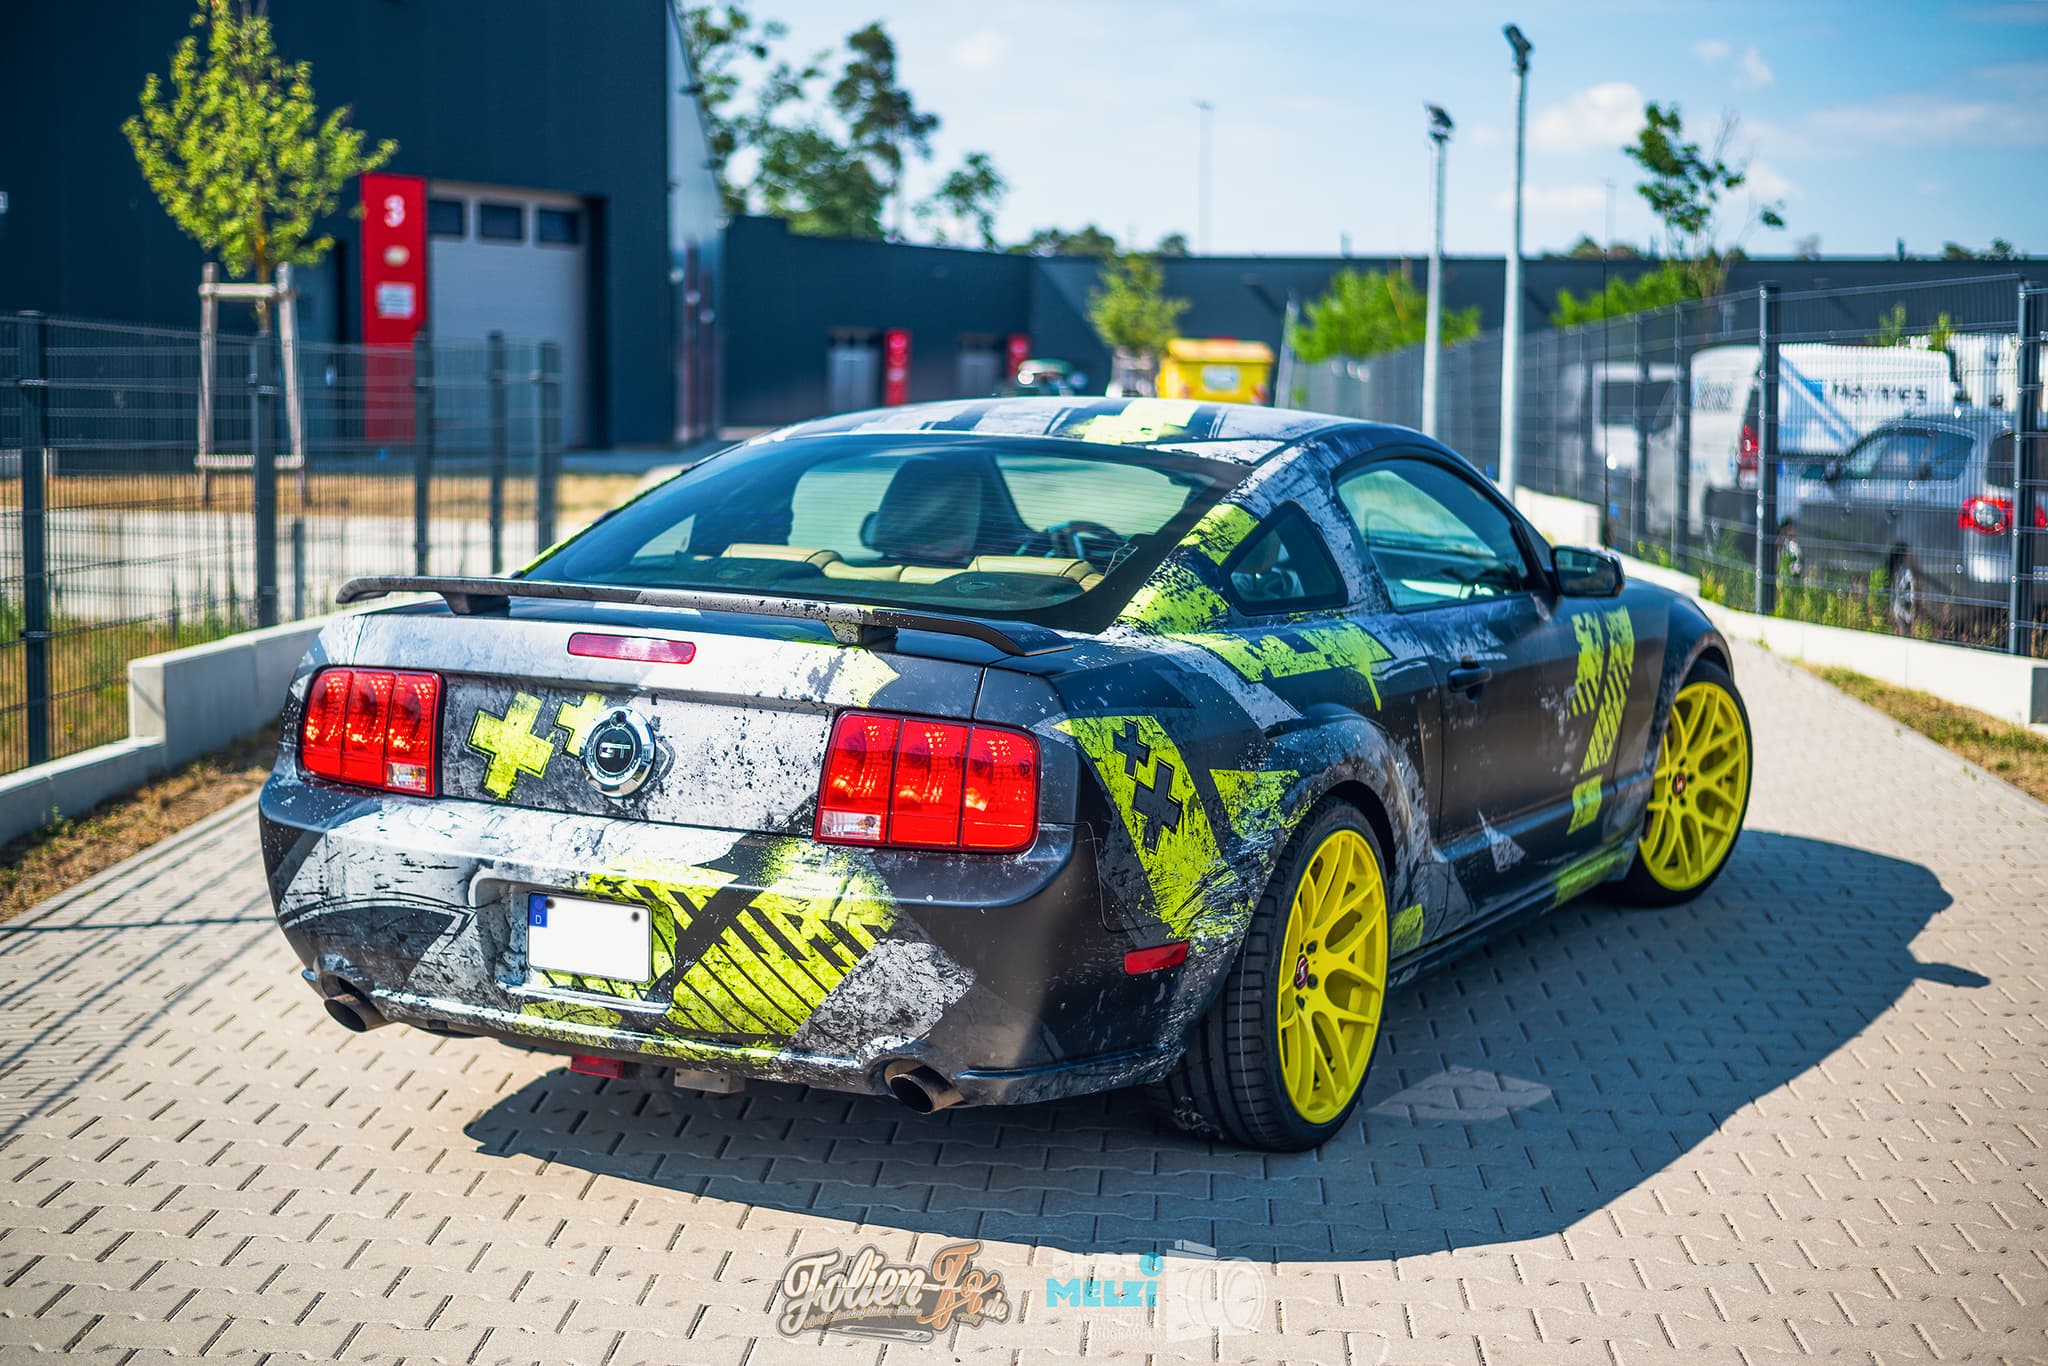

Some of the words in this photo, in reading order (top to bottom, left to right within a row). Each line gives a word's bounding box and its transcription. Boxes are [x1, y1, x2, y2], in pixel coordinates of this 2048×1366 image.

[383, 195, 405, 228] 3
[599, 742, 631, 759] GT
[535, 914, 542, 925] D
